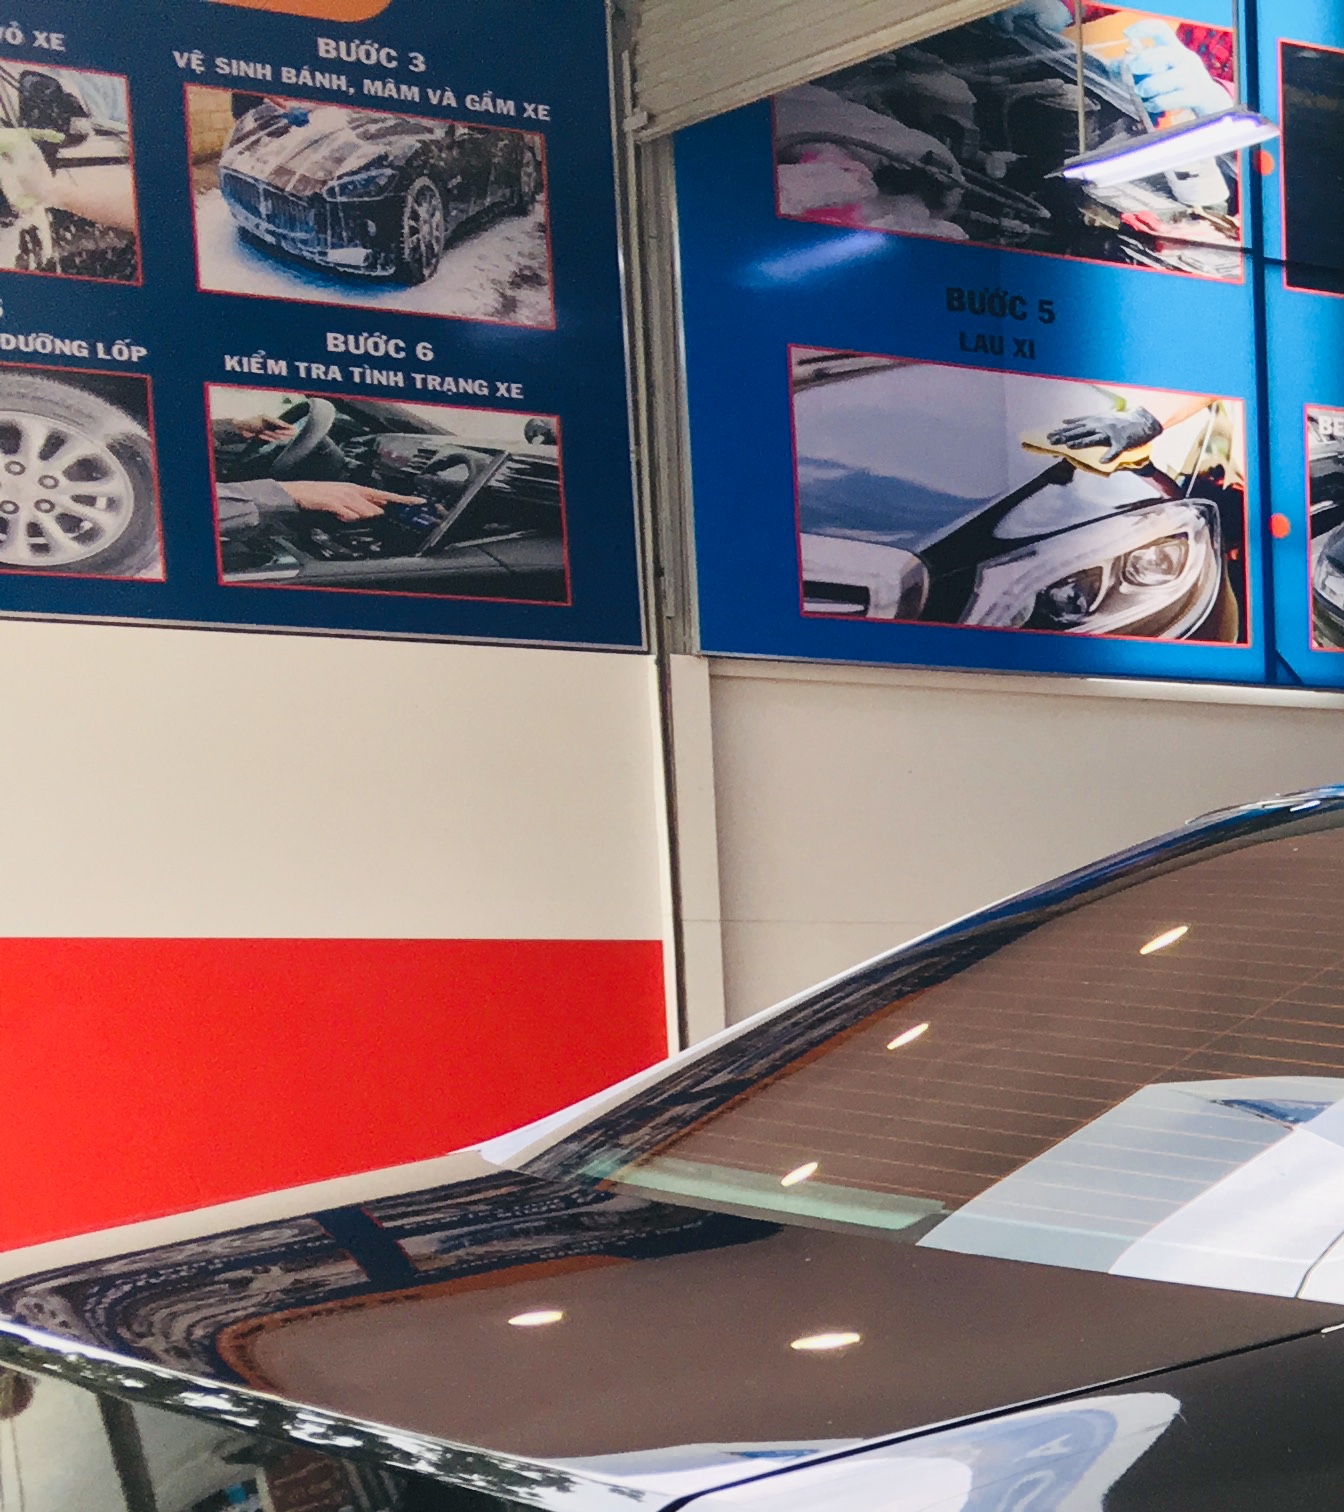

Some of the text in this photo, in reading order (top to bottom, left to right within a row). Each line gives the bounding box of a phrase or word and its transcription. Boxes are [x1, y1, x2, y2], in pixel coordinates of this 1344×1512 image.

[33, 30, 65, 51] XE
[317, 37, 427, 73] BƯỚC 3
[172, 50, 206, 75] VỆ
[214, 56, 272, 82] SINH
[427, 87, 458, 108] VÀ
[523, 102, 551, 121] XE
[947, 287, 1056, 324] BƯỚC 5
[0, 332, 149, 362] DƯỠNG LỐP
[326, 331, 435, 361] BƯỚC 6
[959, 331, 1005, 355] LAU
[224, 350, 525, 399] KIỂM TRA TÌNH TRẠNG XE
